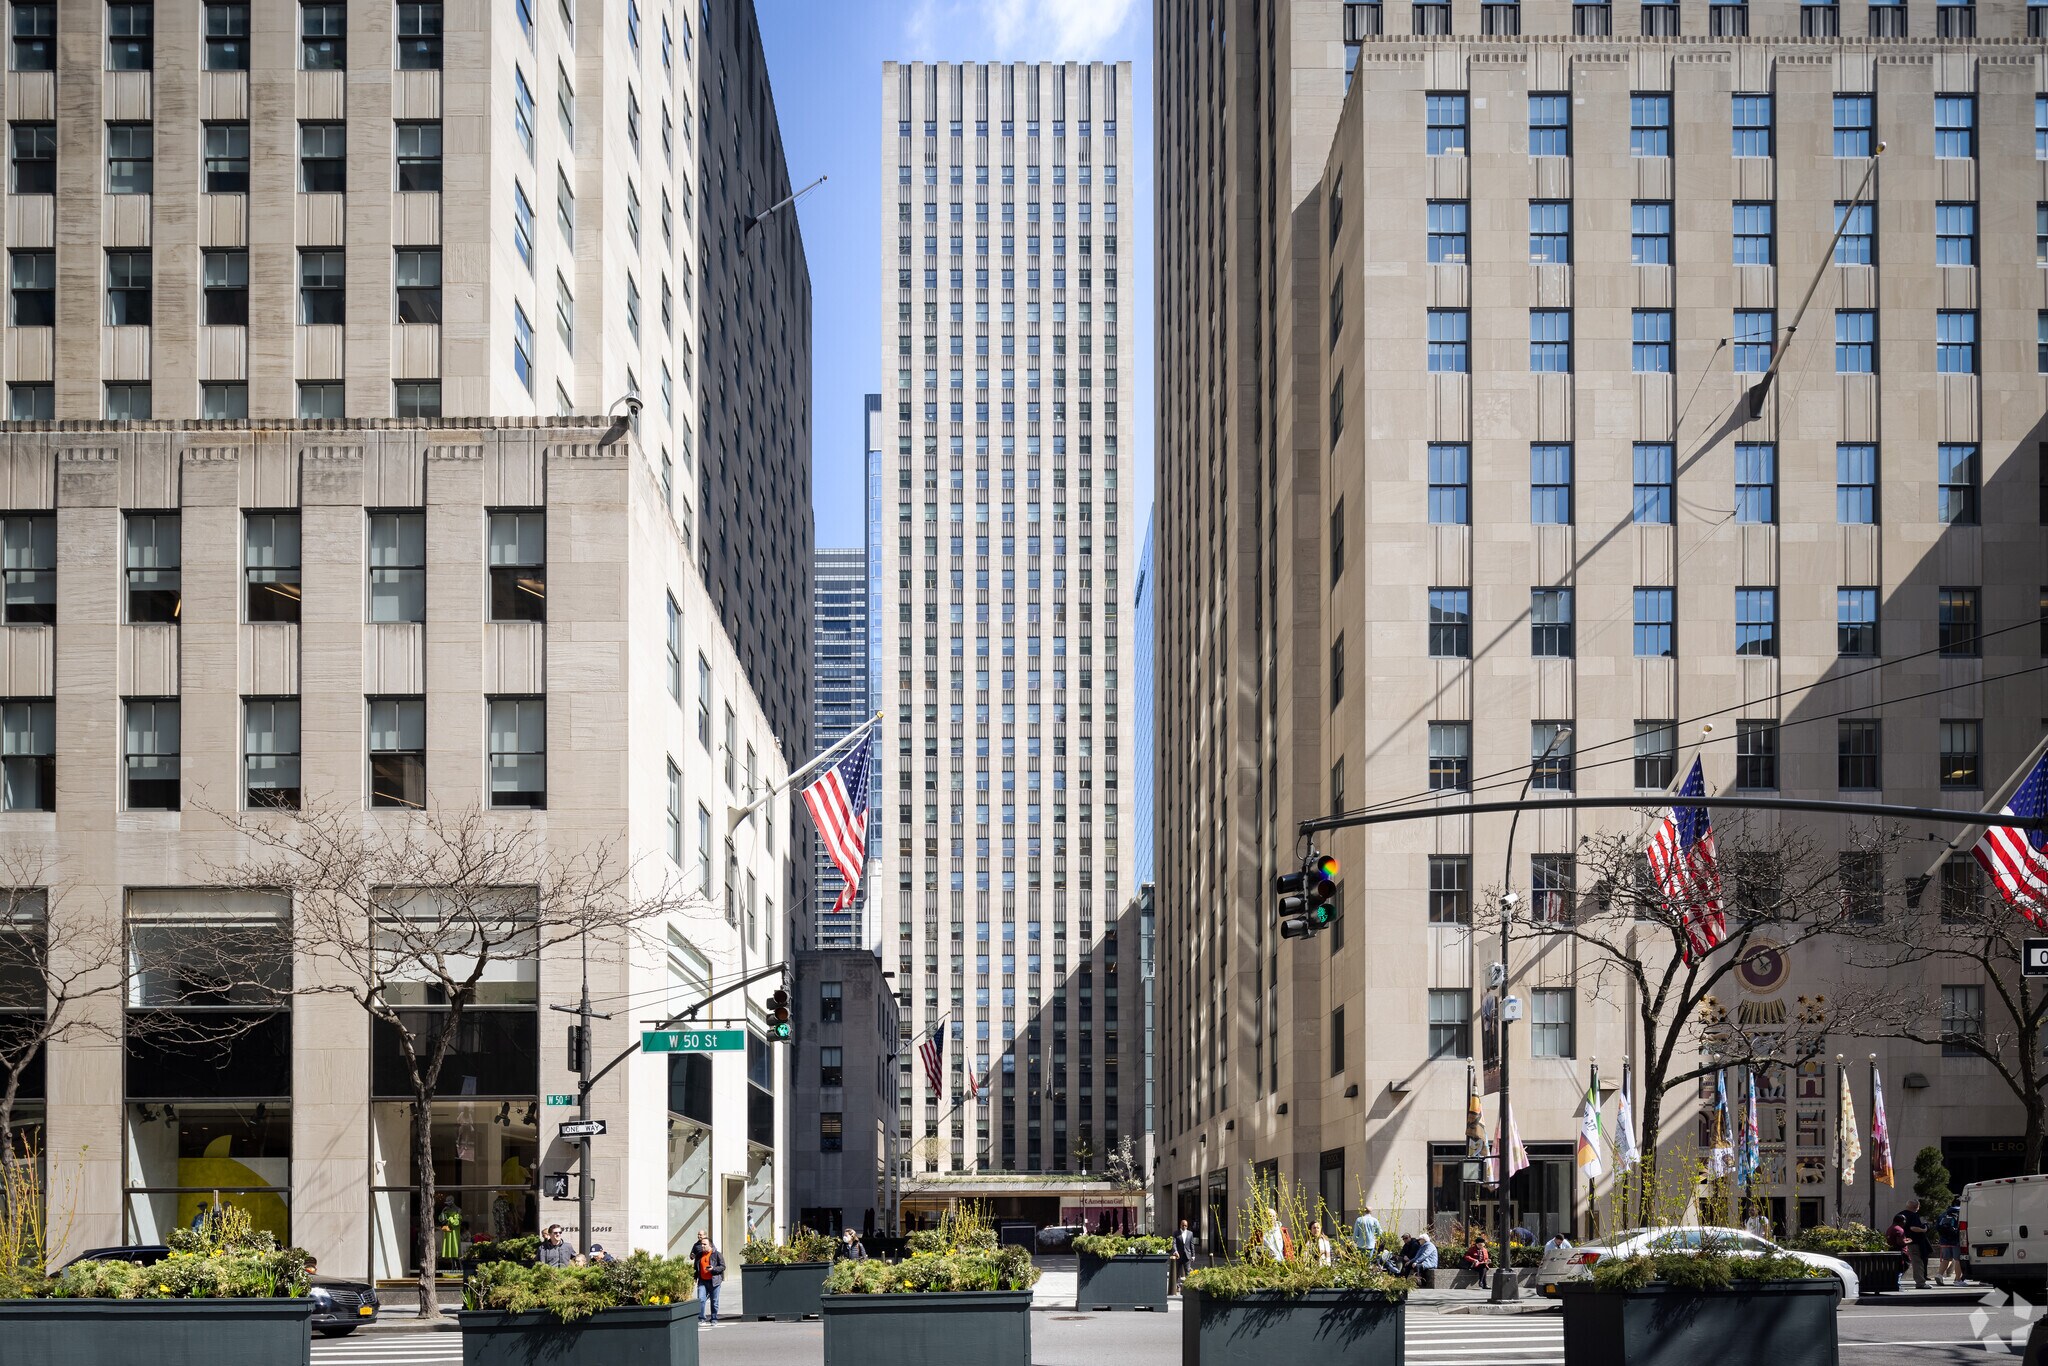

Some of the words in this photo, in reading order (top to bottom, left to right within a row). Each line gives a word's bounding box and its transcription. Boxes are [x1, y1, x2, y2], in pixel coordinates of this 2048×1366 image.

[669, 1035, 679, 1048] W
[683, 1034, 699, 1048] 50
[704, 1034, 718, 1047] St
[548, 1095, 553, 1104] W
[555, 1095, 564, 1104] 50
[585, 1124, 600, 1132] WAY
[1991, 1142, 2005, 1151] LE
[2007, 1142, 2025, 1151] RO
